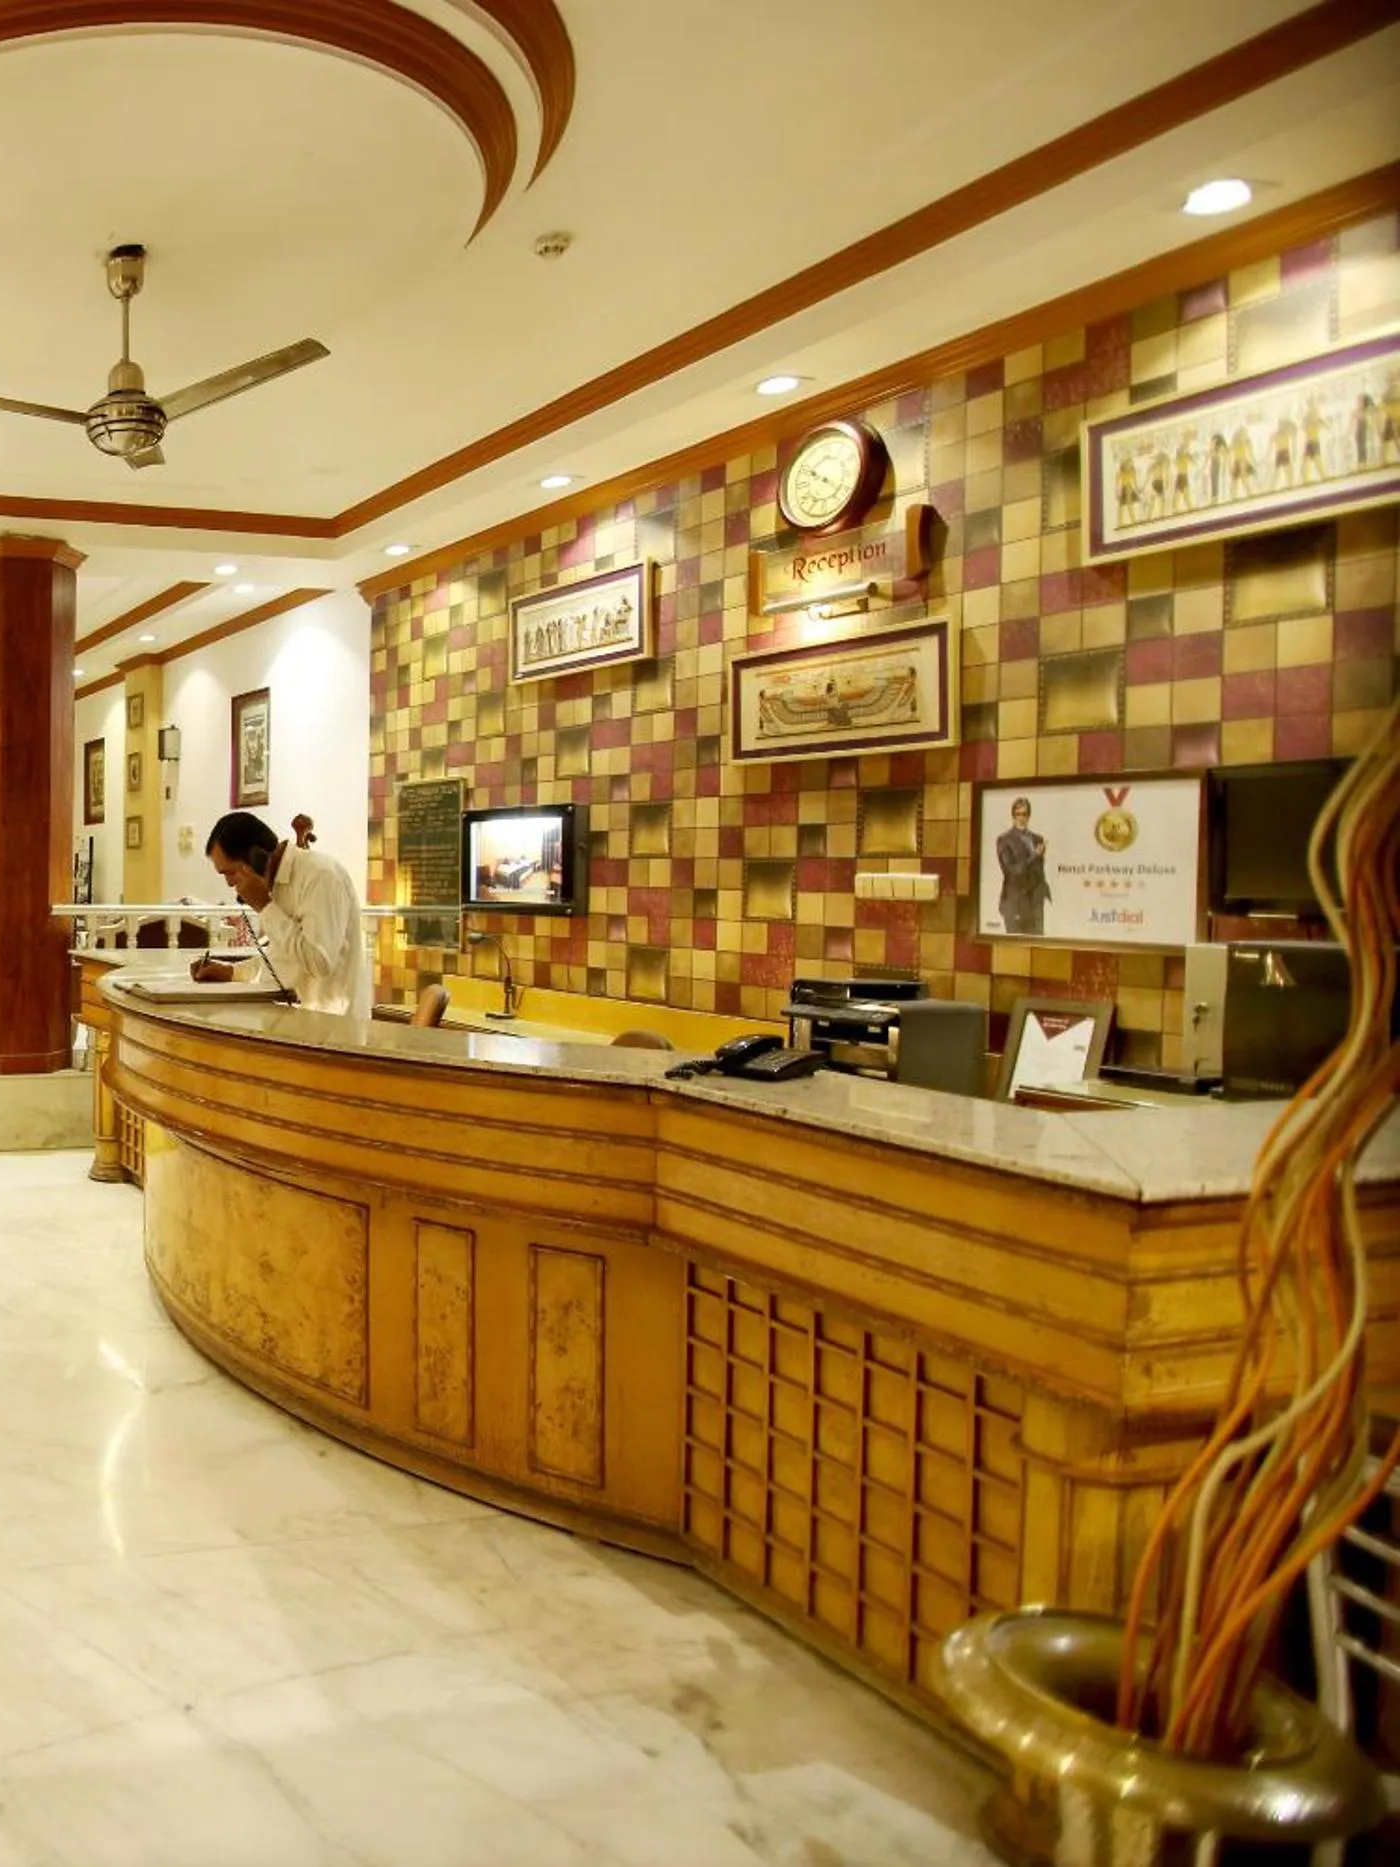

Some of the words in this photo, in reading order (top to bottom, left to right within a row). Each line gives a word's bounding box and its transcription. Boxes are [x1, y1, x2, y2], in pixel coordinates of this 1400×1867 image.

[793, 542, 886, 582] Reception
[1058, 864, 1085, 875] Hotel
[1088, 864, 1133, 876] Parkway
[1137, 864, 1176, 875] Deluxe
[1088, 908, 1143, 925] Justdial
